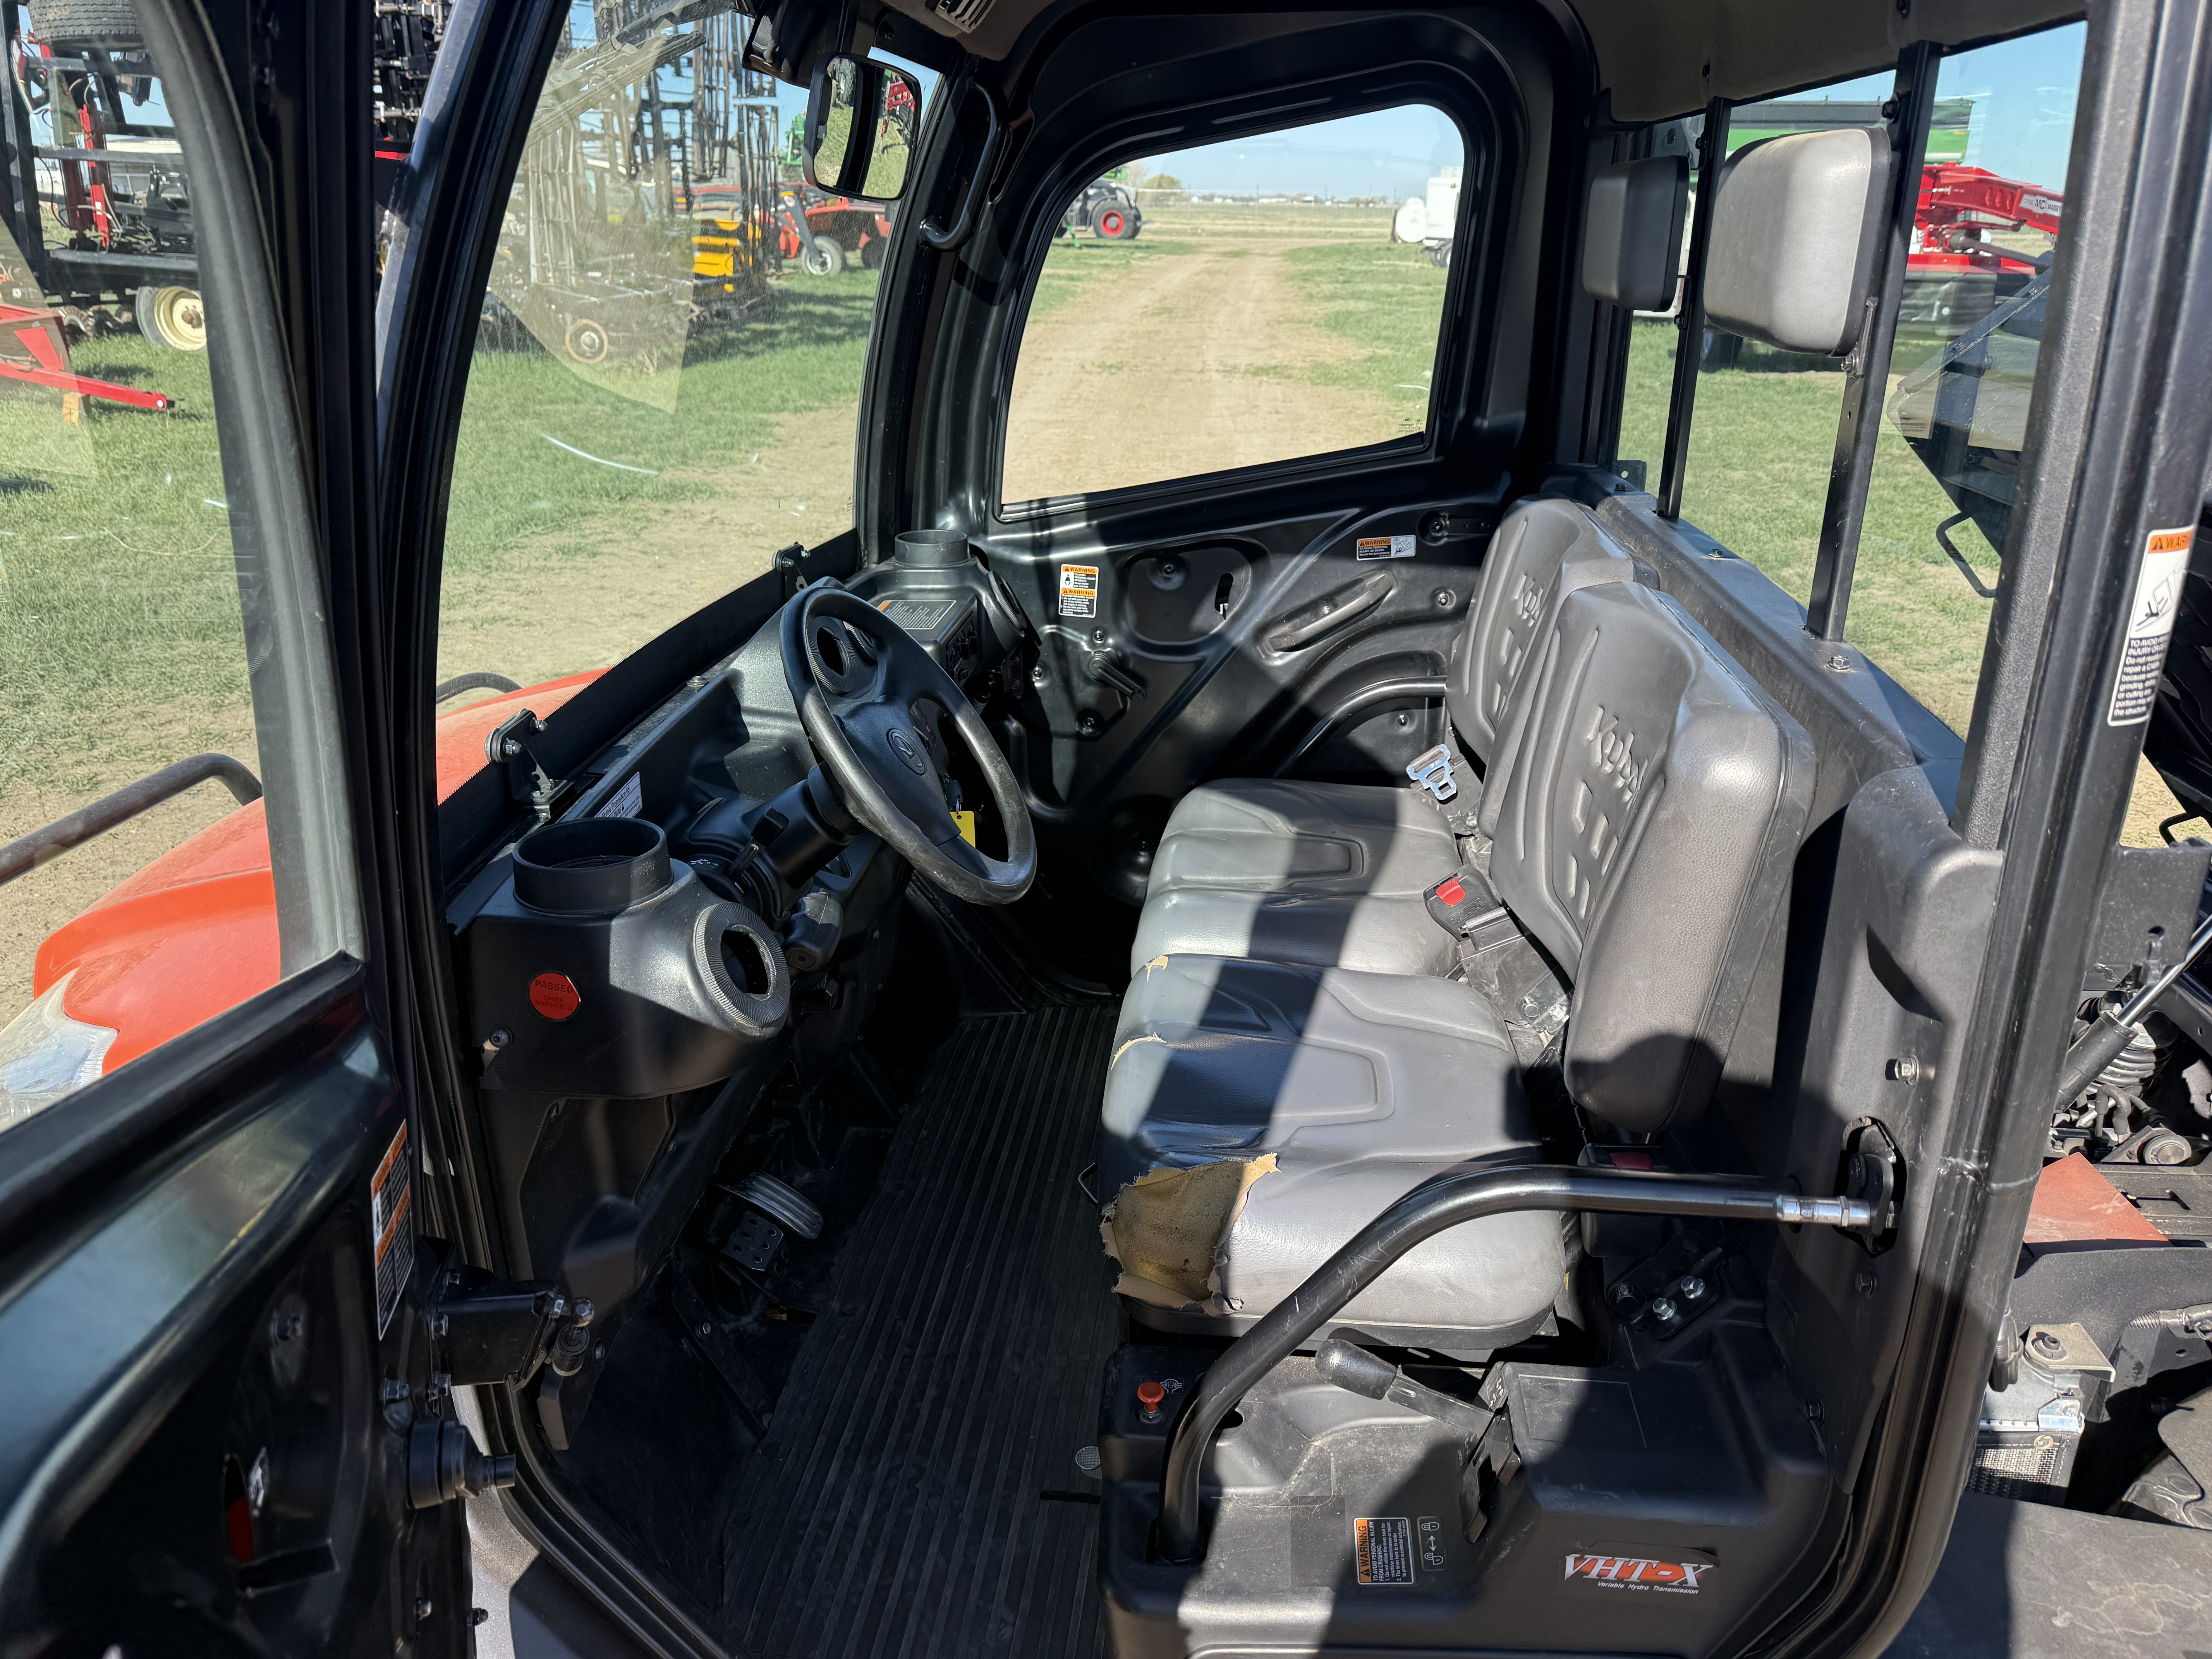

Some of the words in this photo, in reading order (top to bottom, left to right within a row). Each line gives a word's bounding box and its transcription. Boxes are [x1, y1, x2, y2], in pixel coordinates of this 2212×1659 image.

[2140, 637, 2158, 646] AVOID
[2128, 647, 2150, 656] INJURY
[535, 980, 574, 993] PASSED
[543, 995, 564, 1003] CHIEF
[534, 1000, 573, 1011] INSPECTOR
[1358, 1526, 1369, 1567] WARNING
[1564, 1554, 1714, 1588] VHT-X
[1597, 1581, 1625, 1589] Variable
[1653, 1585, 1699, 1595] Transmission
